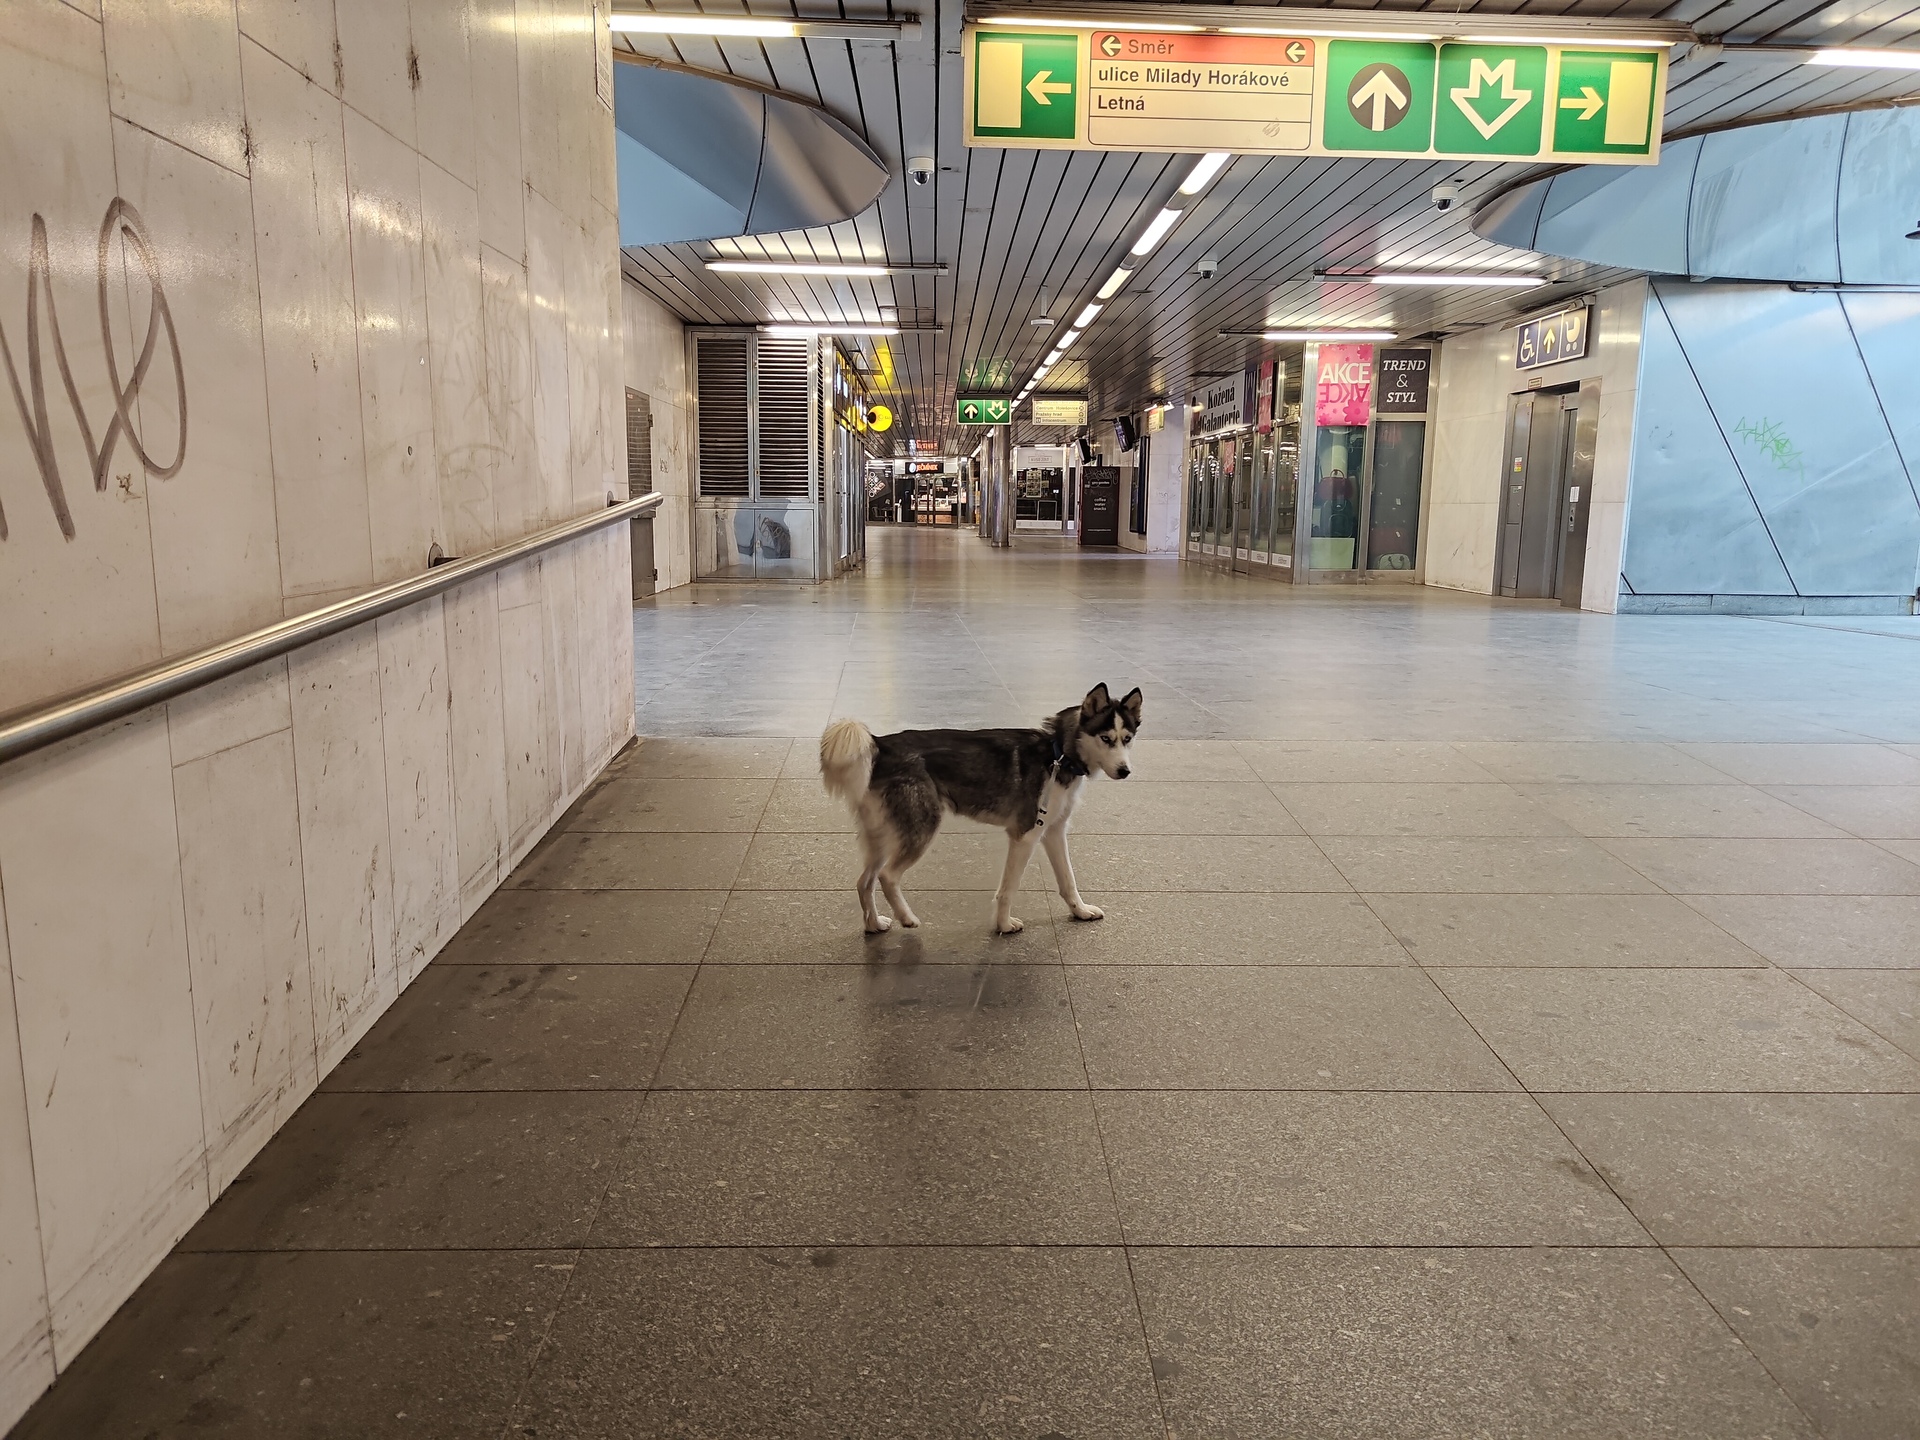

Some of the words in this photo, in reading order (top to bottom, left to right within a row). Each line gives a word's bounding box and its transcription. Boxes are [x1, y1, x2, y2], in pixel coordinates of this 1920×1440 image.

[1128, 39, 1175, 55] Směr
[1098, 66, 1140, 83] ulice
[1146, 67, 1202, 88] Milady
[1208, 70, 1290, 87] Horákové
[1097, 94, 1145, 111] Letná
[1318, 363, 1371, 384] AKCE
[1383, 360, 1427, 371] TREND
[1396, 373, 1408, 388] &
[1207, 380, 1235, 410] Kožená
[1386, 392, 1416, 403] STYL
[1200, 405, 1241, 433] Galanterie
